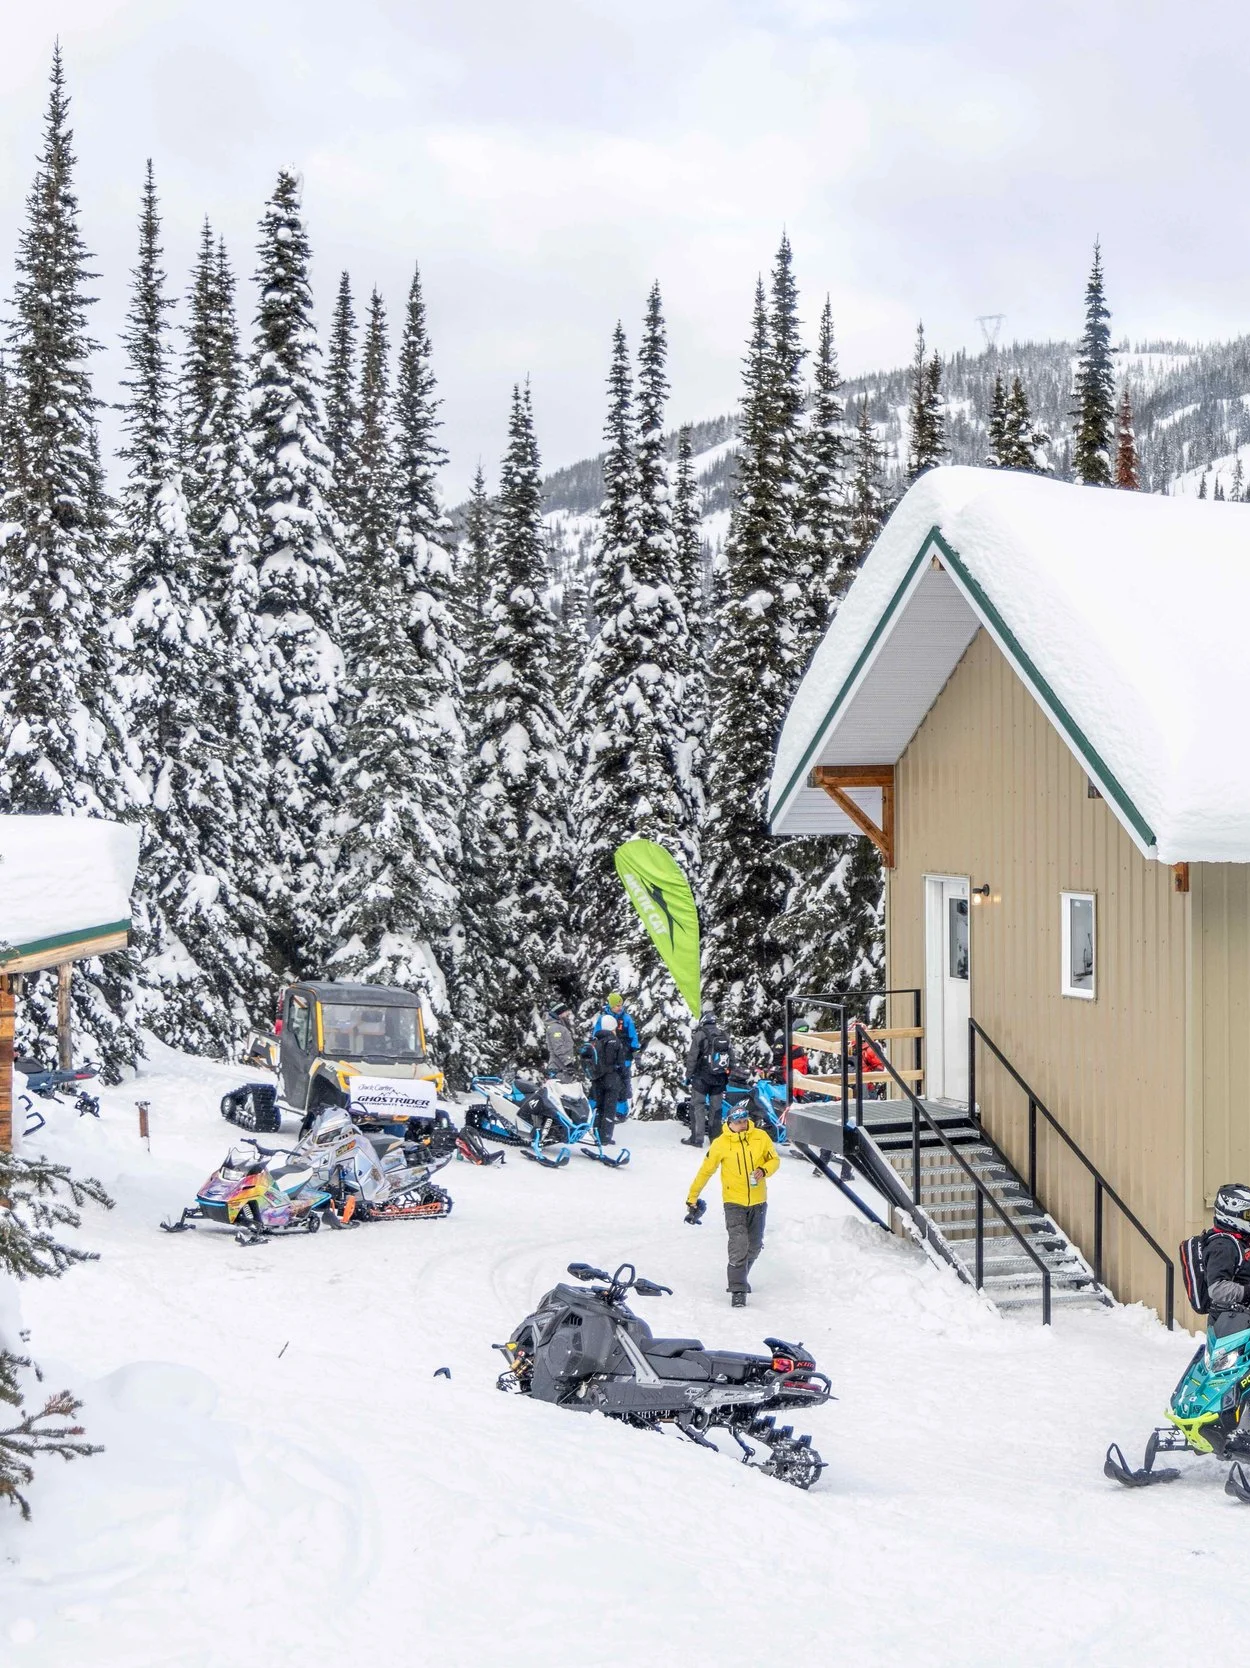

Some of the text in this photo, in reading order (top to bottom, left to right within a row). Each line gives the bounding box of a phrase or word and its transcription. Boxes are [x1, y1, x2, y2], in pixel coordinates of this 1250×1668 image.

[623, 873, 668, 935] ARCTIC CAT
[357, 1095, 430, 1106] GHOSTRIDER
